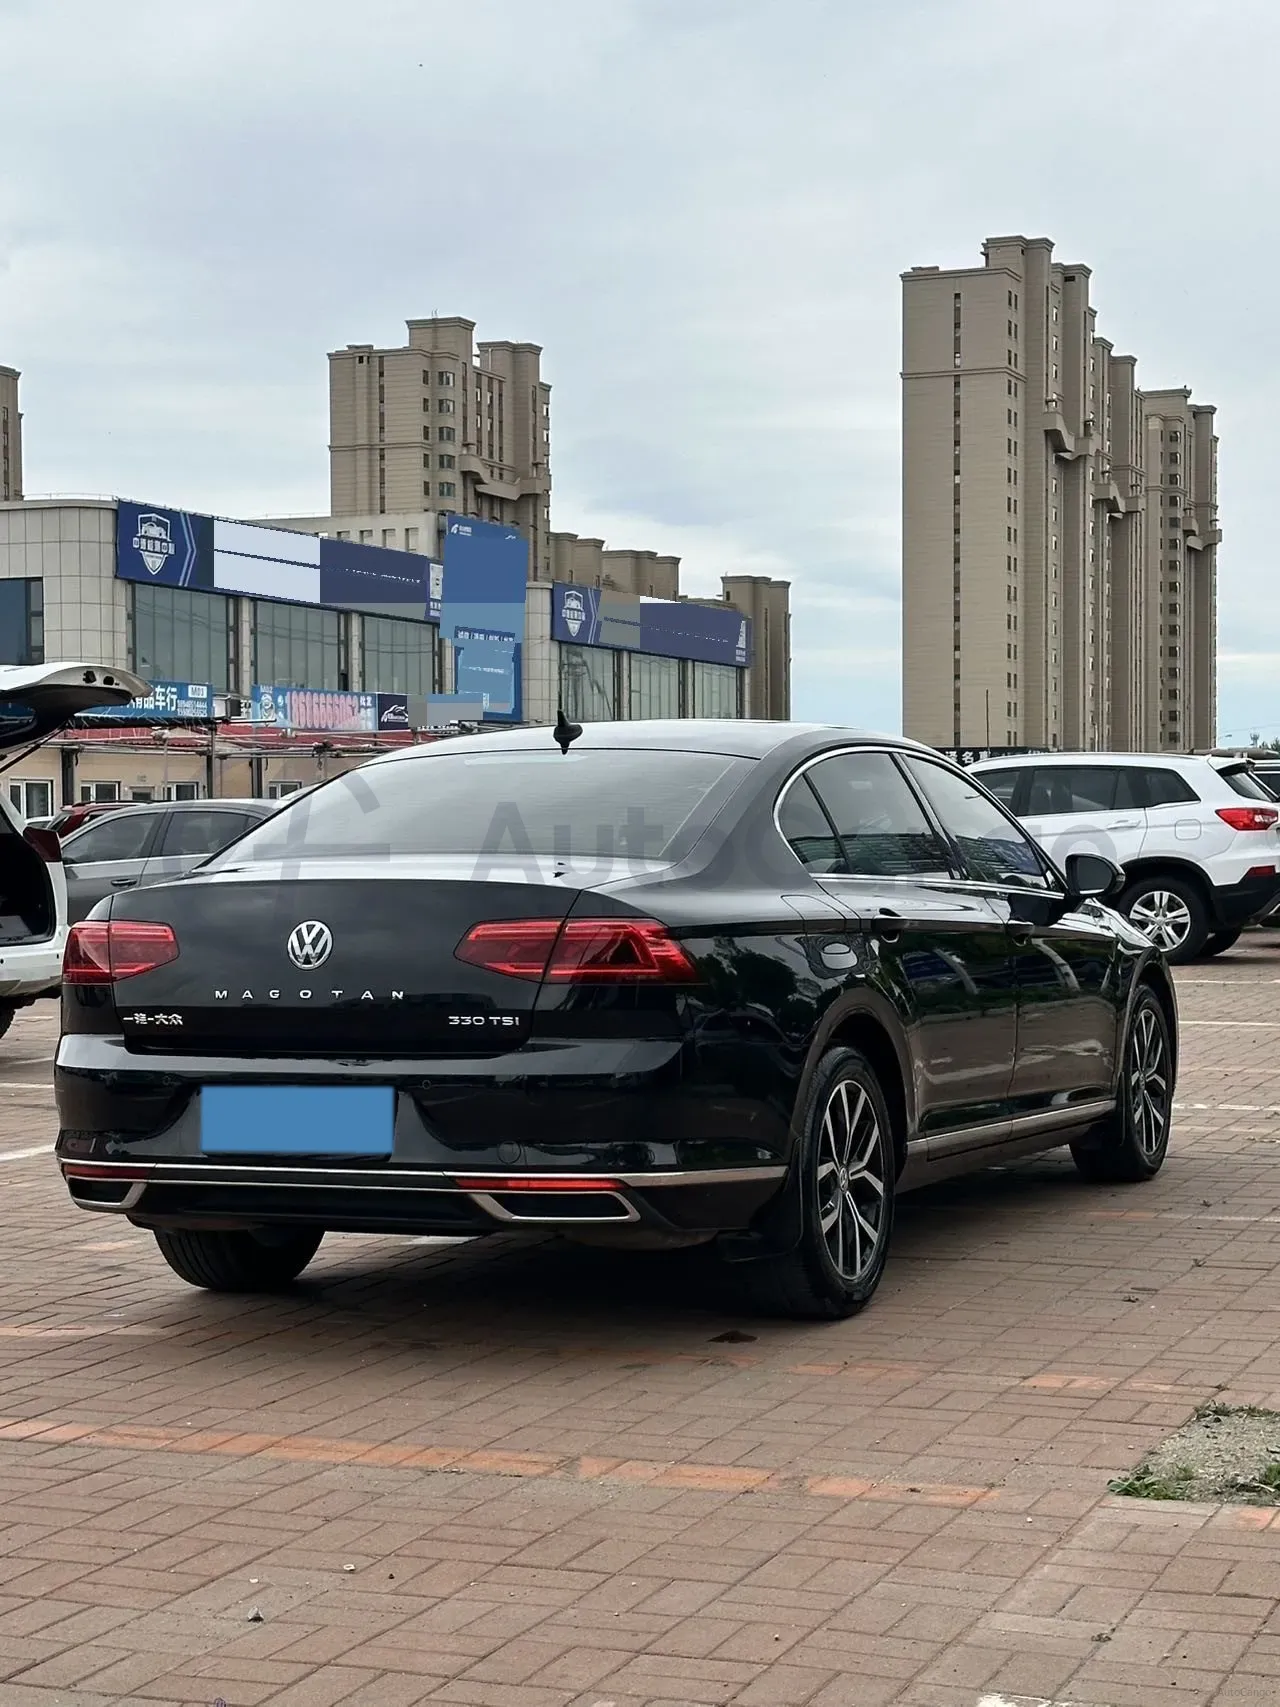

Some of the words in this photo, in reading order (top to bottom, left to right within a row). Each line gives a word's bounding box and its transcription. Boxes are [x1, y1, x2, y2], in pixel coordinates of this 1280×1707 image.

[214, 989, 405, 1000] MAGOTAN
[448, 1015, 485, 1026] 330
[488, 1016, 520, 1026] TSI
